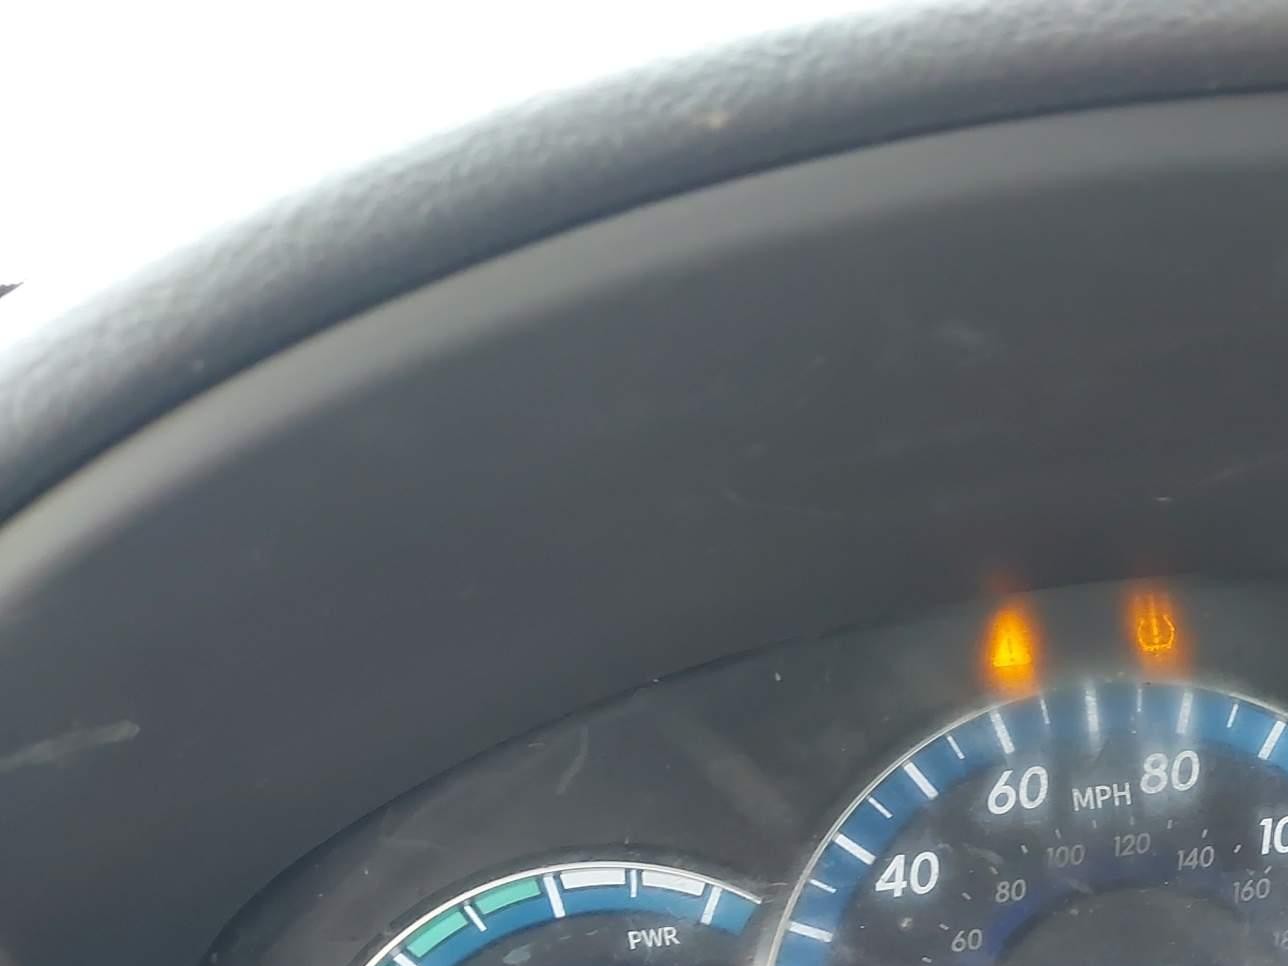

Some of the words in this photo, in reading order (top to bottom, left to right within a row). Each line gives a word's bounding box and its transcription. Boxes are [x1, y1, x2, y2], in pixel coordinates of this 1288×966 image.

[1140, 750, 1200, 795] 80
[987, 766, 1048, 815] 60
[1072, 782, 1132, 812] MPH
[1047, 844, 1085, 868] 100
[1114, 833, 1151, 857] 120
[1176, 845, 1215, 871] 140
[875, 851, 940, 897] 40
[995, 879, 1026, 903] 80
[1234, 878, 1270, 903] 160
[628, 927, 680, 950] PWR
[951, 928, 983, 953] 60
